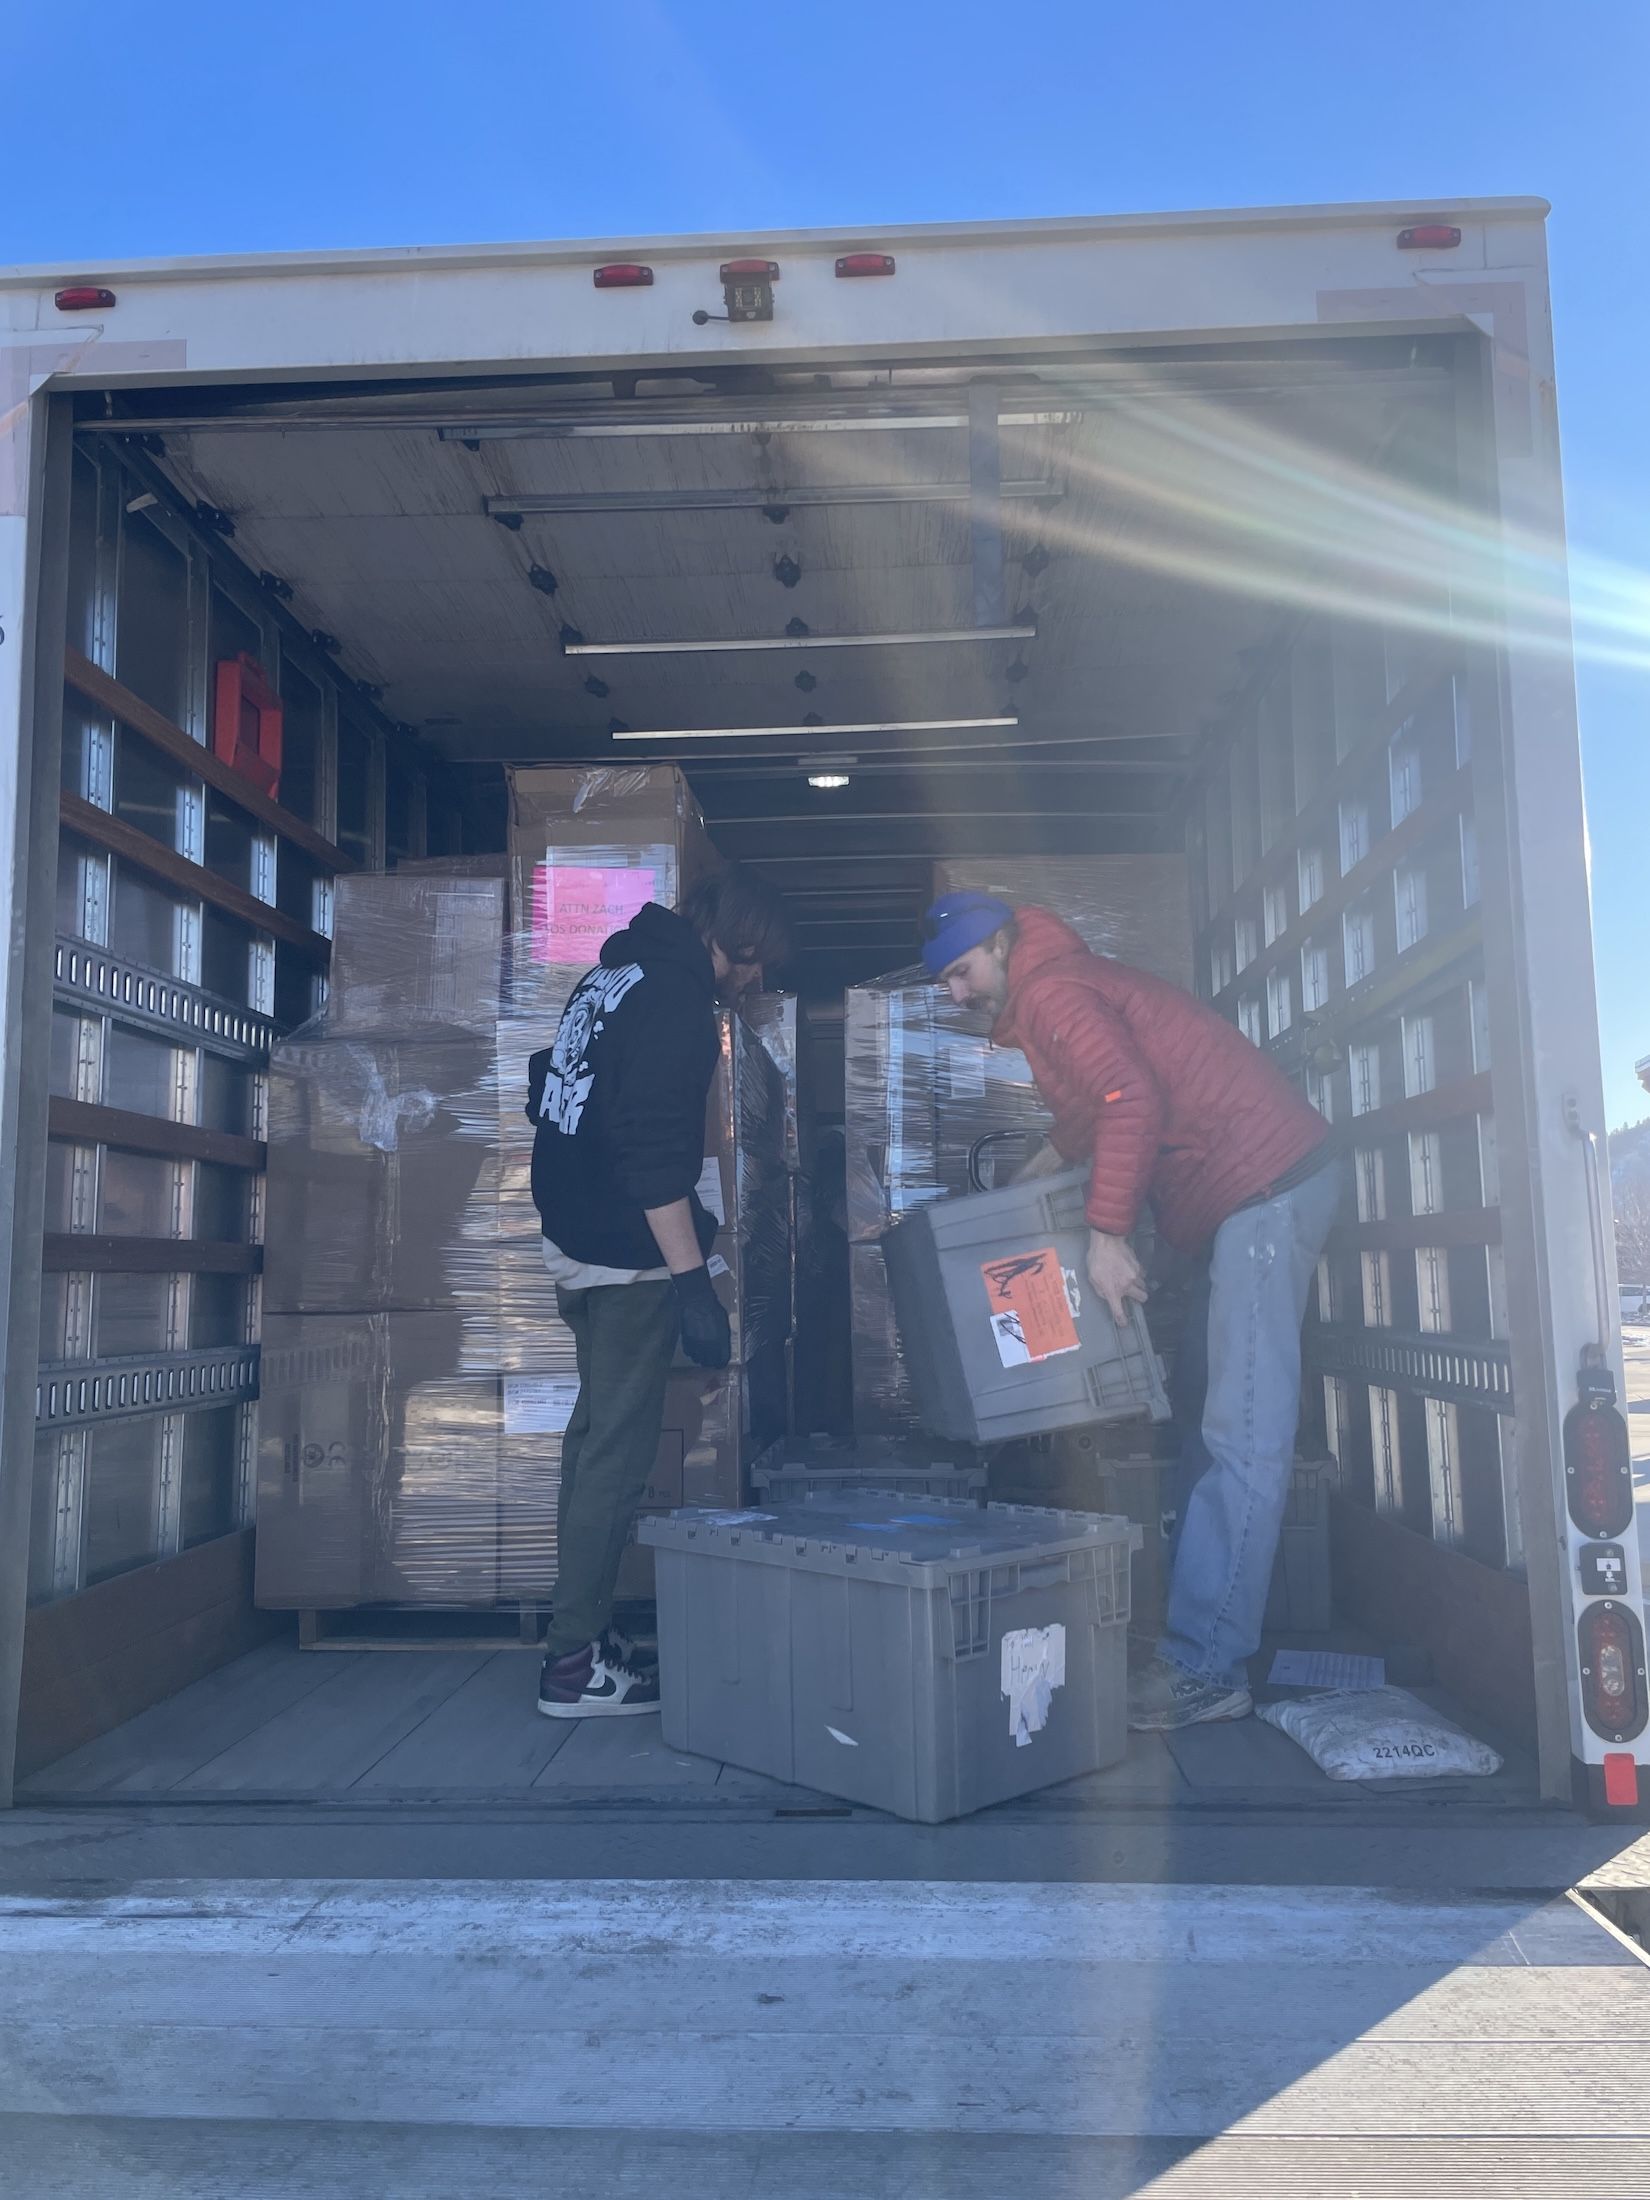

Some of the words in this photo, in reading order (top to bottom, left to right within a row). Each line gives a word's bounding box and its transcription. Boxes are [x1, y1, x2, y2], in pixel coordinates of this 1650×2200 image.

[559, 903, 589, 914] ATTN
[591, 903, 624, 915] ZACH
[1372, 1743, 1435, 1759] 2214QC
